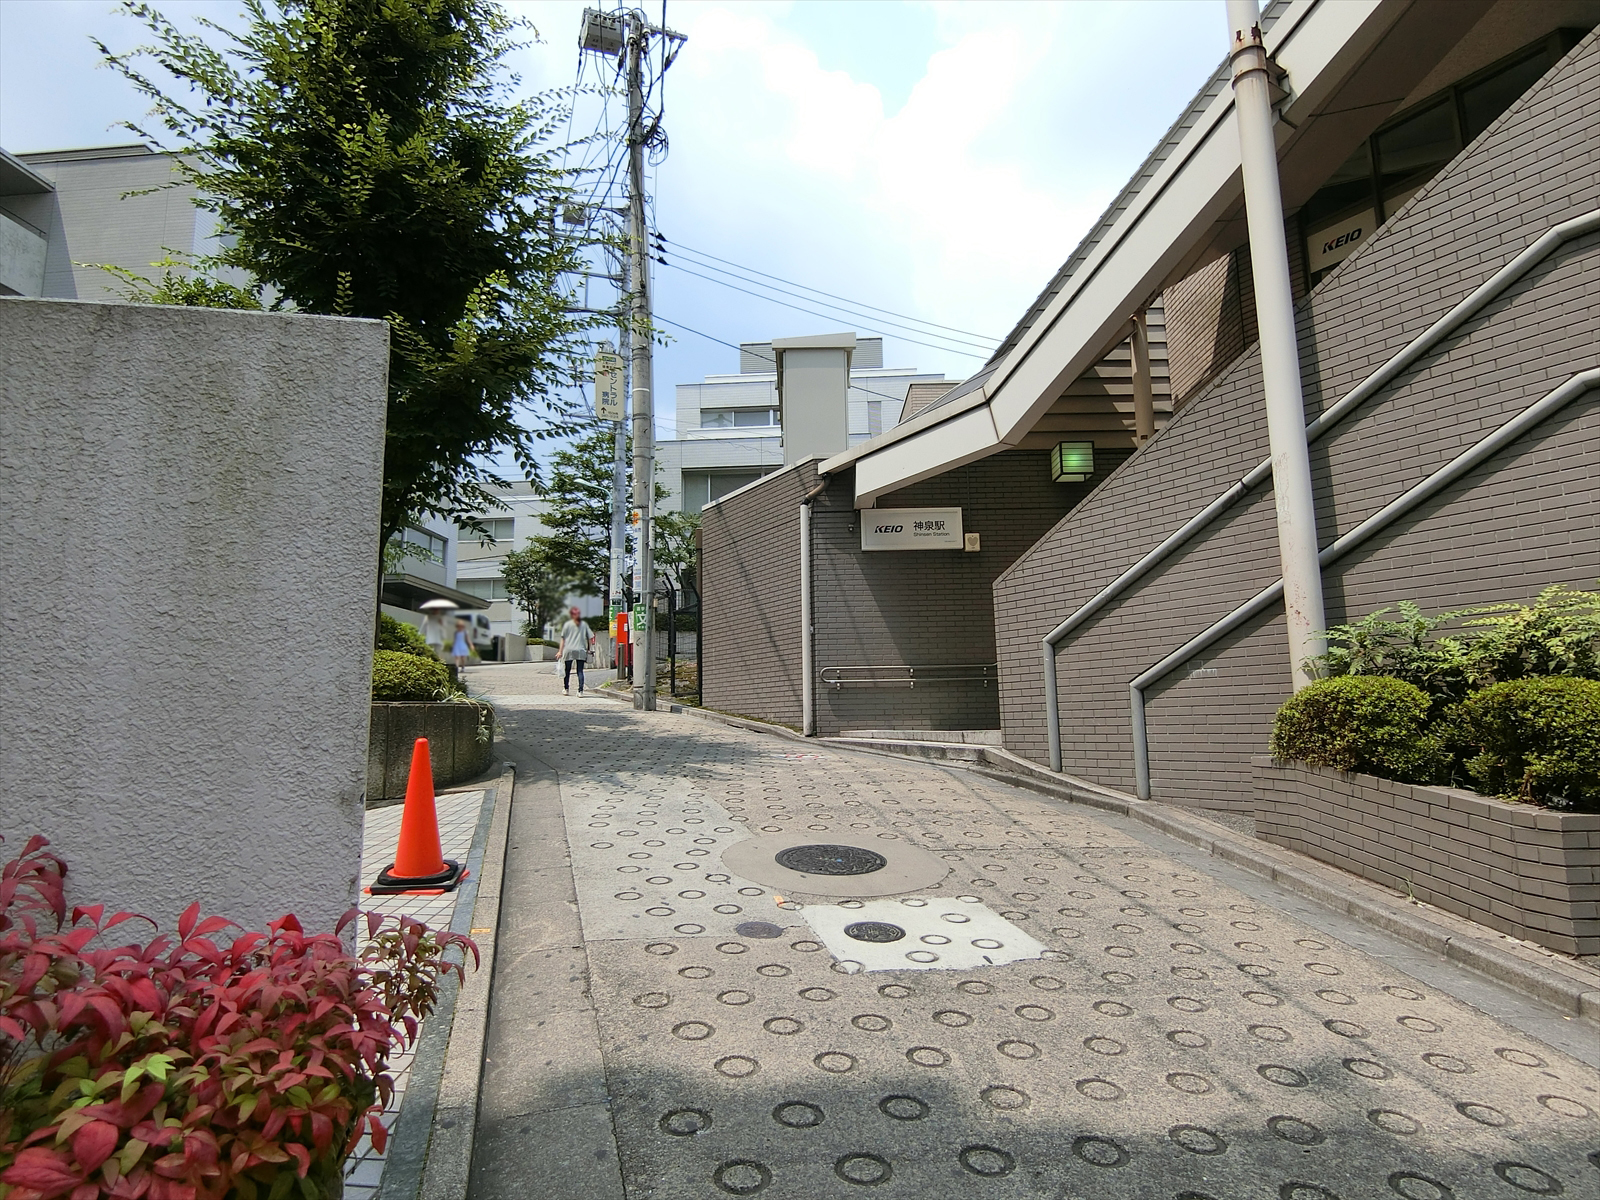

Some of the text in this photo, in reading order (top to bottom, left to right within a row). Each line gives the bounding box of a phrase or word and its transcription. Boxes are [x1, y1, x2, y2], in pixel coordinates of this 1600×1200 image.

[1322, 228, 1362, 254] KEIO
[609, 371, 618, 406] セントラル
[875, 525, 904, 533] KEIO
[913, 520, 945, 531] 神泉駅
